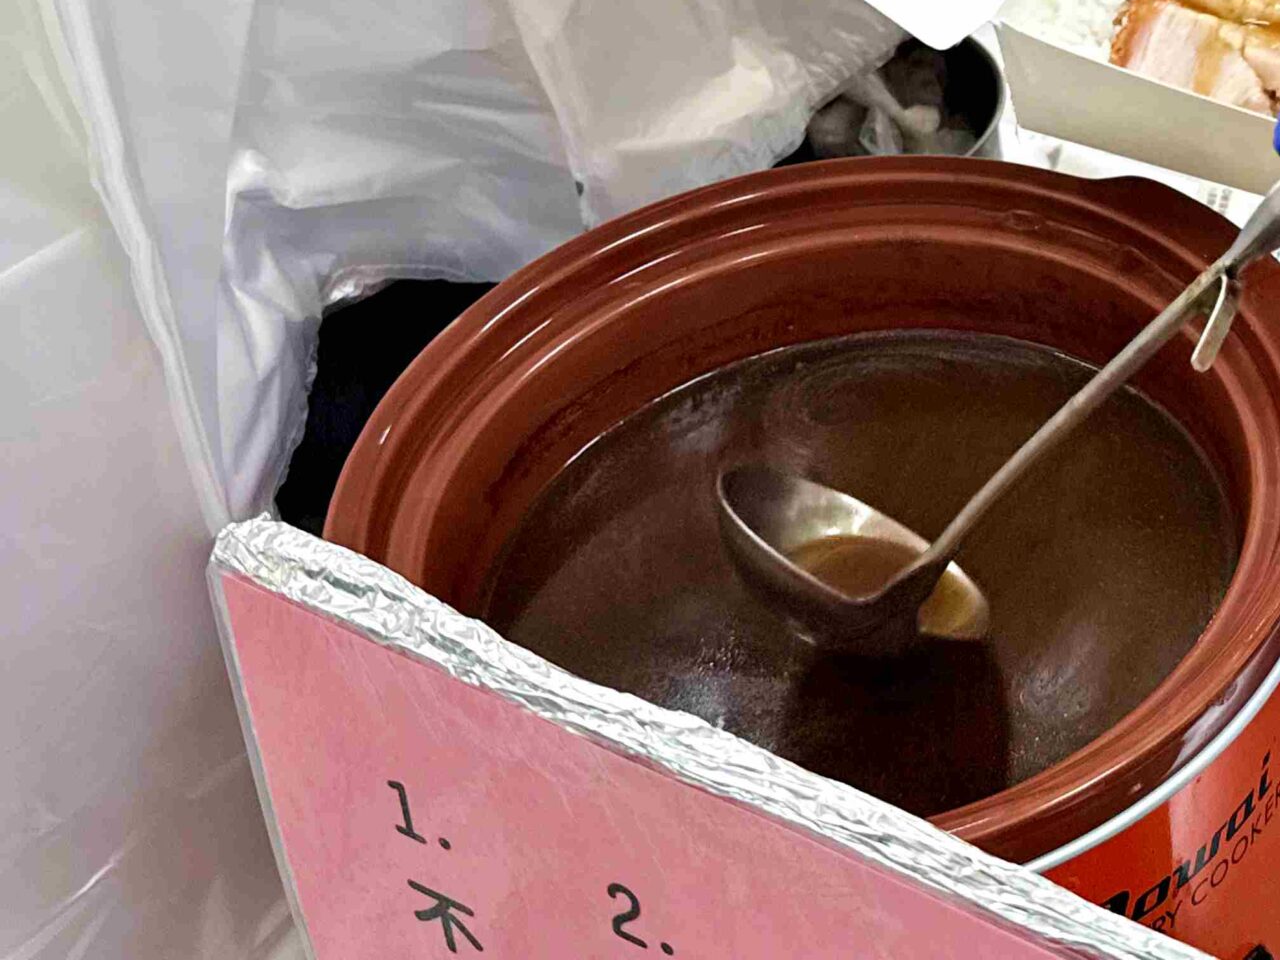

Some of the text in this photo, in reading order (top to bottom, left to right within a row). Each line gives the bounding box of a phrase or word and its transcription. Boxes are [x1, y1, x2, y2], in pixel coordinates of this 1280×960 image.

[387, 780, 451, 850] 1.
[407, 878, 484, 954] 不
[607, 882, 675, 956] 2.
